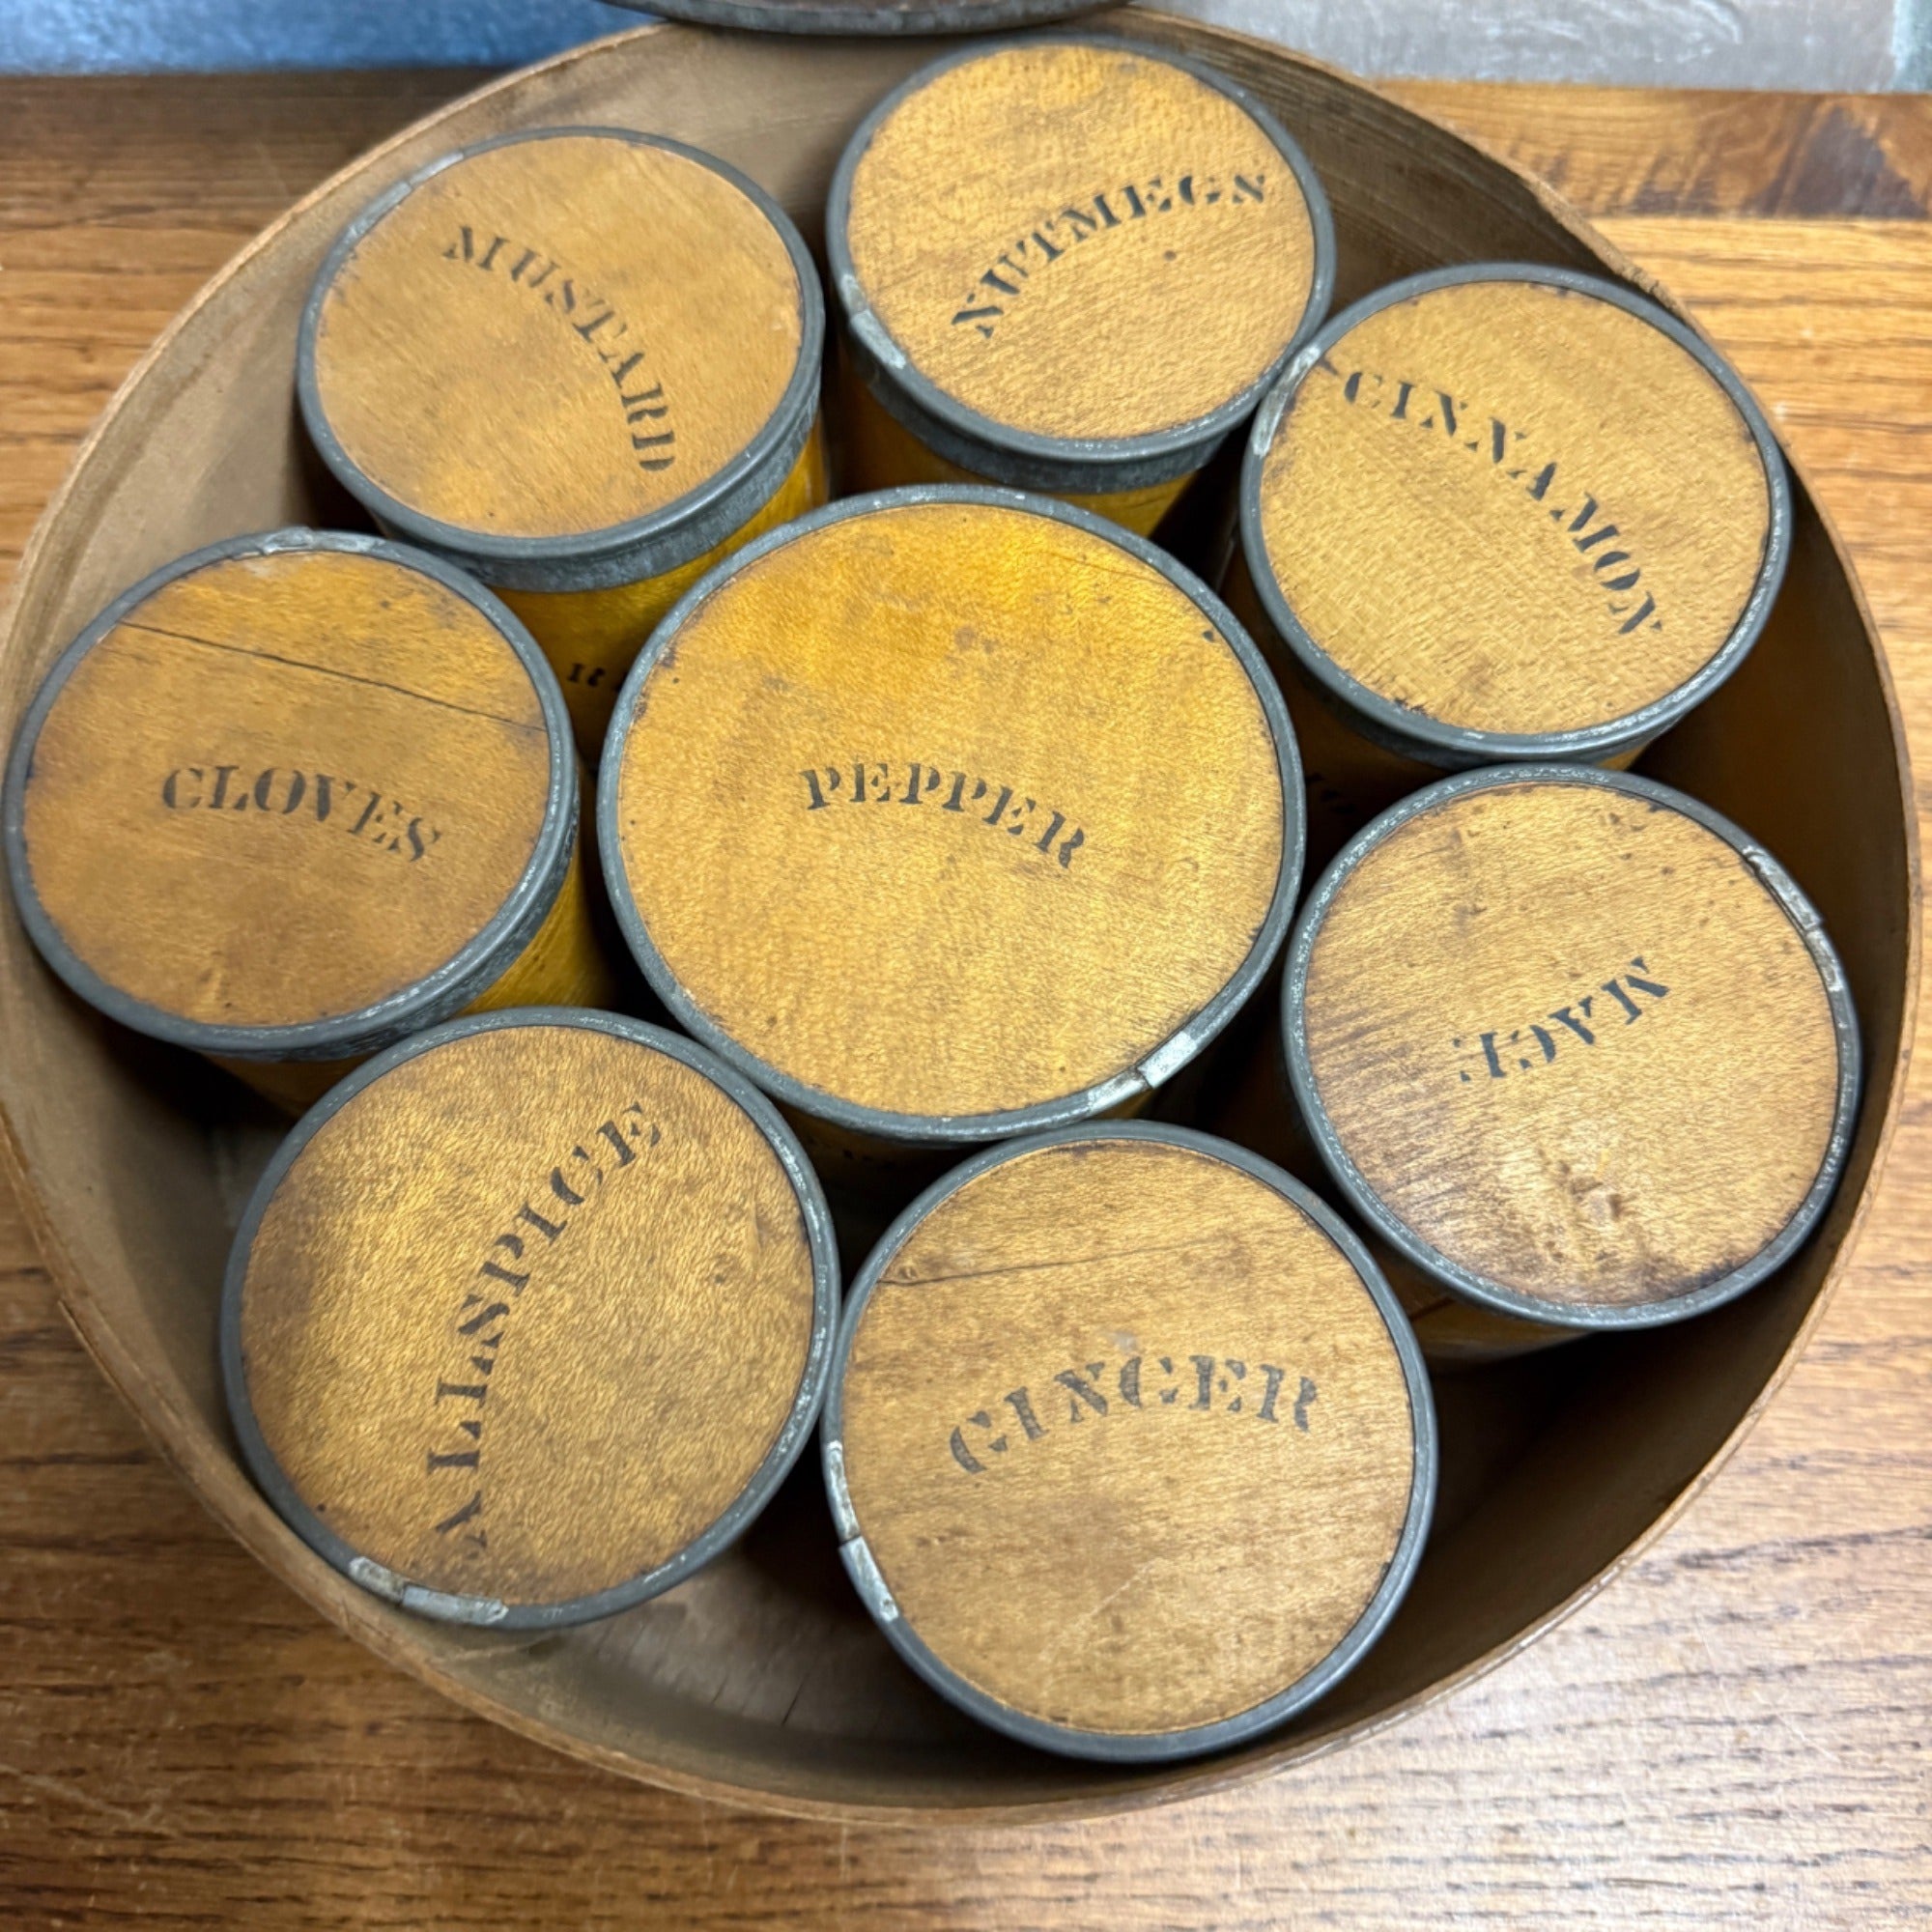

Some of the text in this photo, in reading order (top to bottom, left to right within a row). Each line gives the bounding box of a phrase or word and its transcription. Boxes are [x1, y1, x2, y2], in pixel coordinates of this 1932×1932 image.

[951, 174, 1265, 339] NUTMEGS
[441, 224, 676, 472] MUSTARD
[1344, 371, 1663, 635] CINNAMON
[161, 764, 442, 862] CLOVES
[800, 762, 1085, 869] PEPPER
[1452, 955, 1671, 1083] MACE
[426, 1100, 662, 1559] ALLSPICE
[949, 1354, 1318, 1474] GINGER
